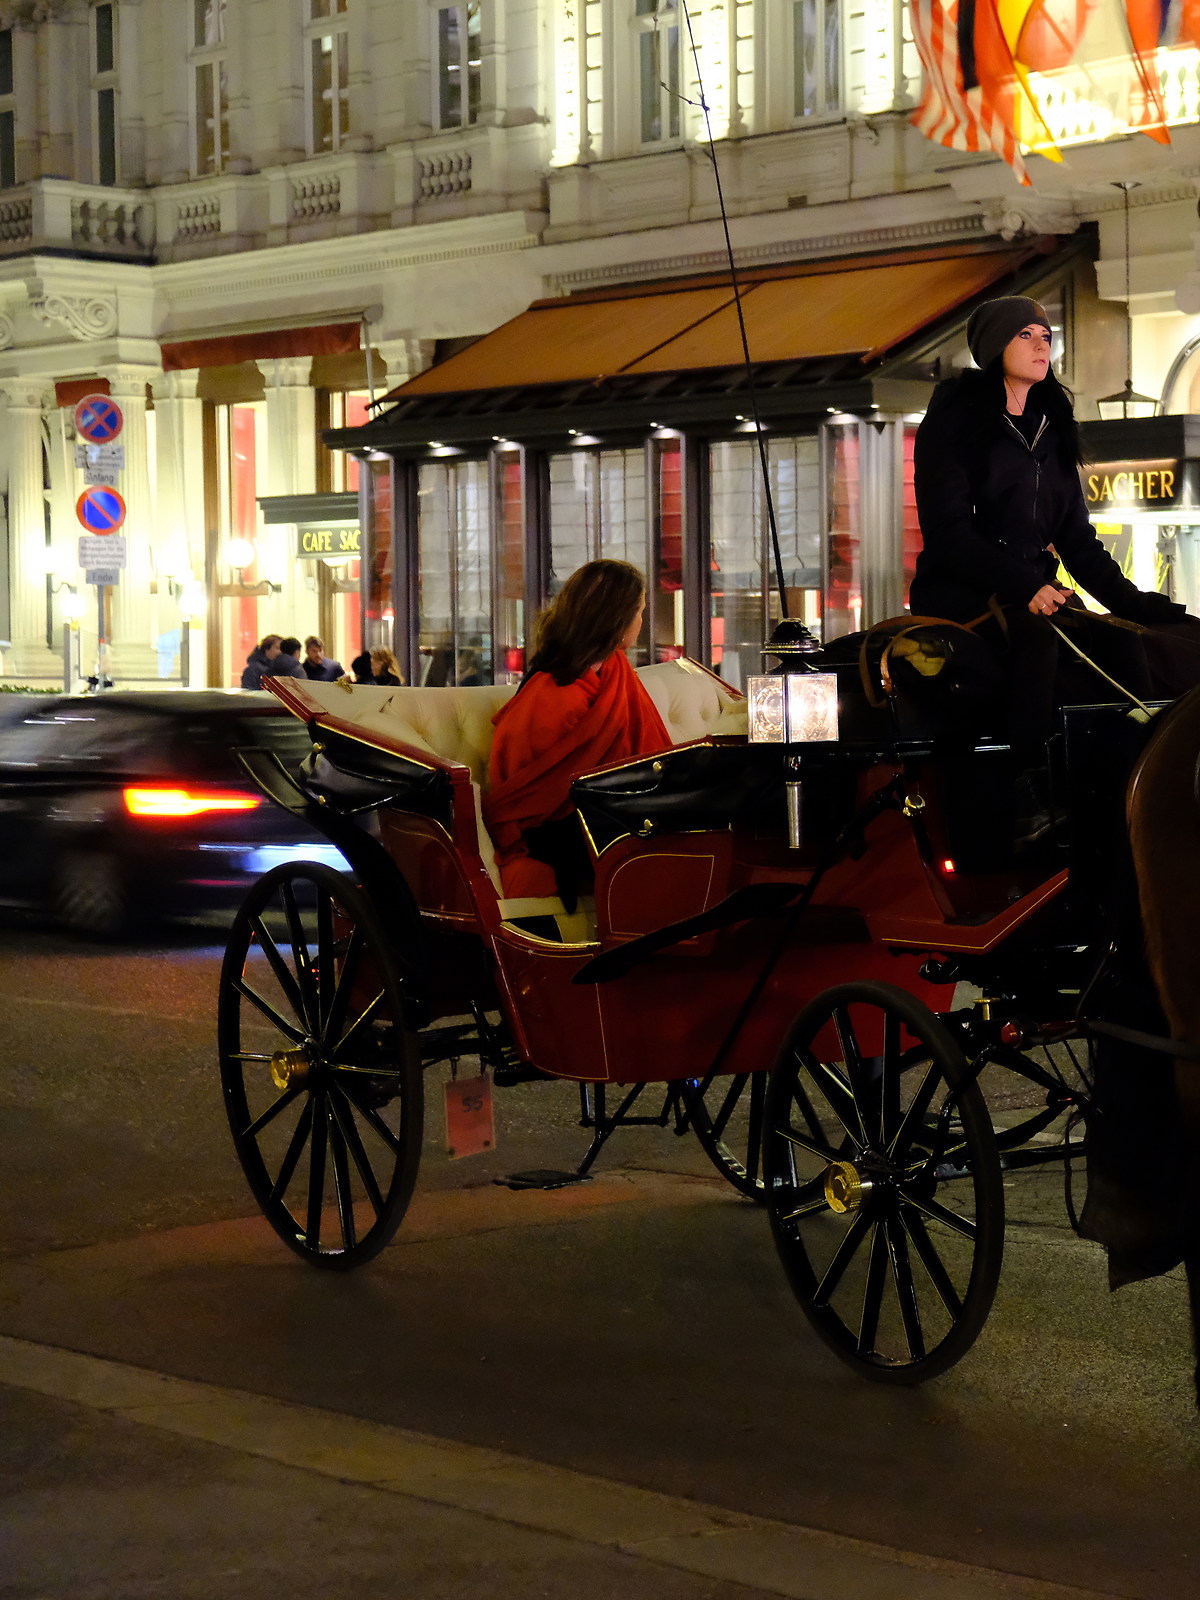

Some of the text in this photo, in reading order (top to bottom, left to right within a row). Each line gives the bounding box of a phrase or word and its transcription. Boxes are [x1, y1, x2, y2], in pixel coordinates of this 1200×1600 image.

[1087, 470, 1175, 502] SACHER
[302, 531, 333, 552] CAFE
[92, 571, 114, 583] Ende
